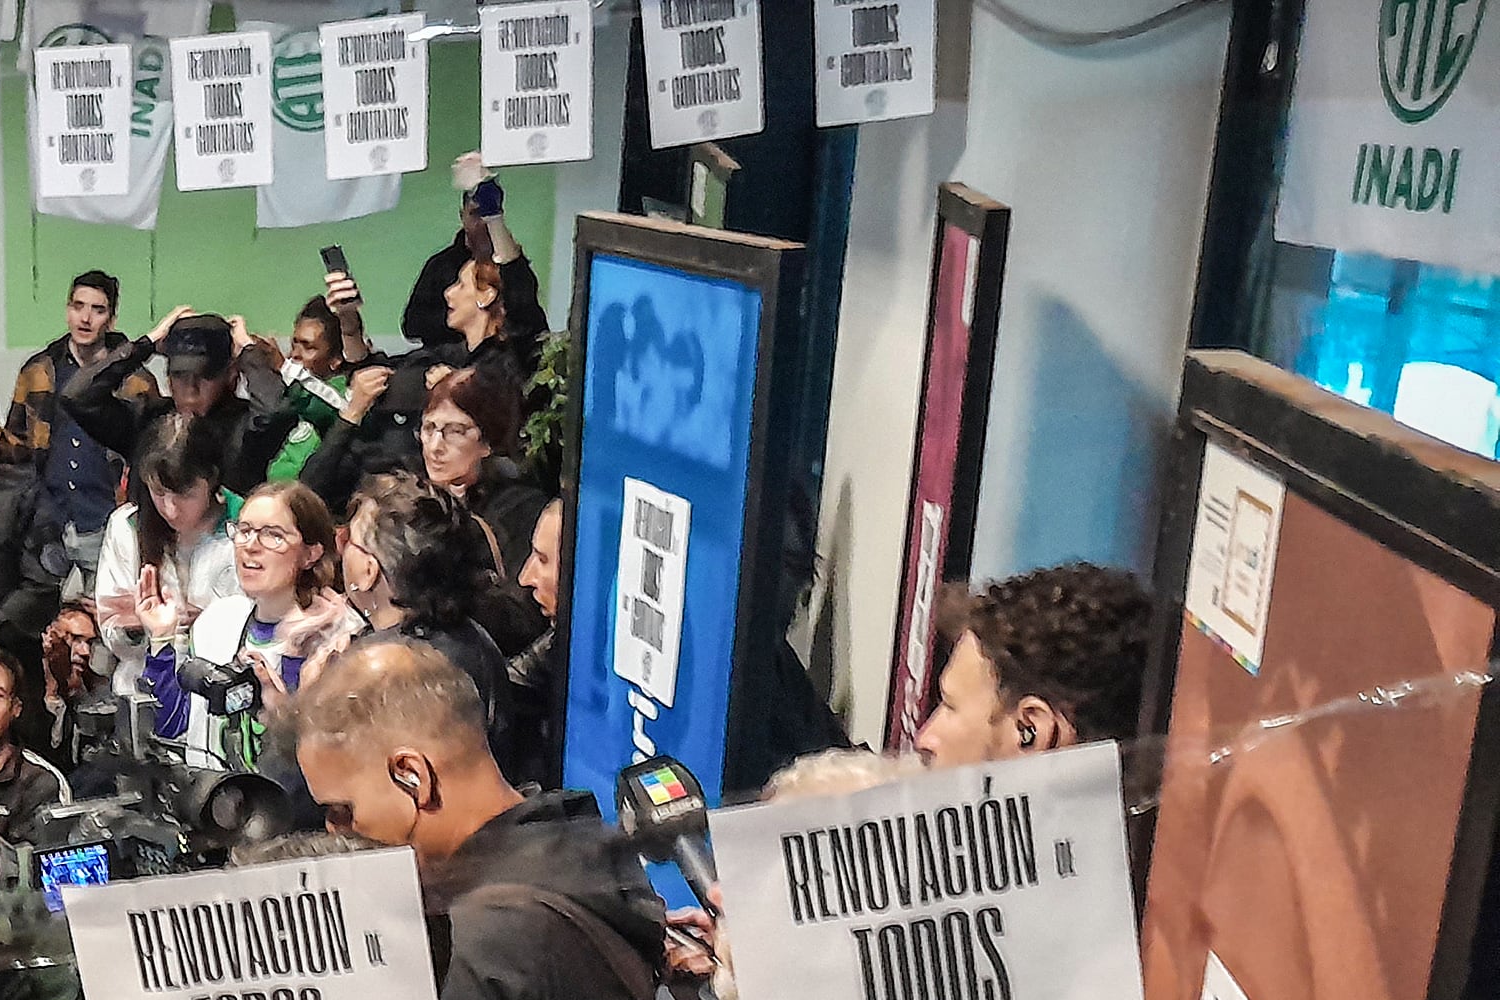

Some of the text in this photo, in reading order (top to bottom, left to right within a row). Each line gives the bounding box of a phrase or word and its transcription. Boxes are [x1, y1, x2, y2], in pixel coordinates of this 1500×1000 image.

[131, 47, 164, 138] INAD
[1352, 143, 1460, 214] INADI
[780, 776, 1040, 924] RENOVACIÓN
[127, 871, 353, 992] RENOVACIÓN
